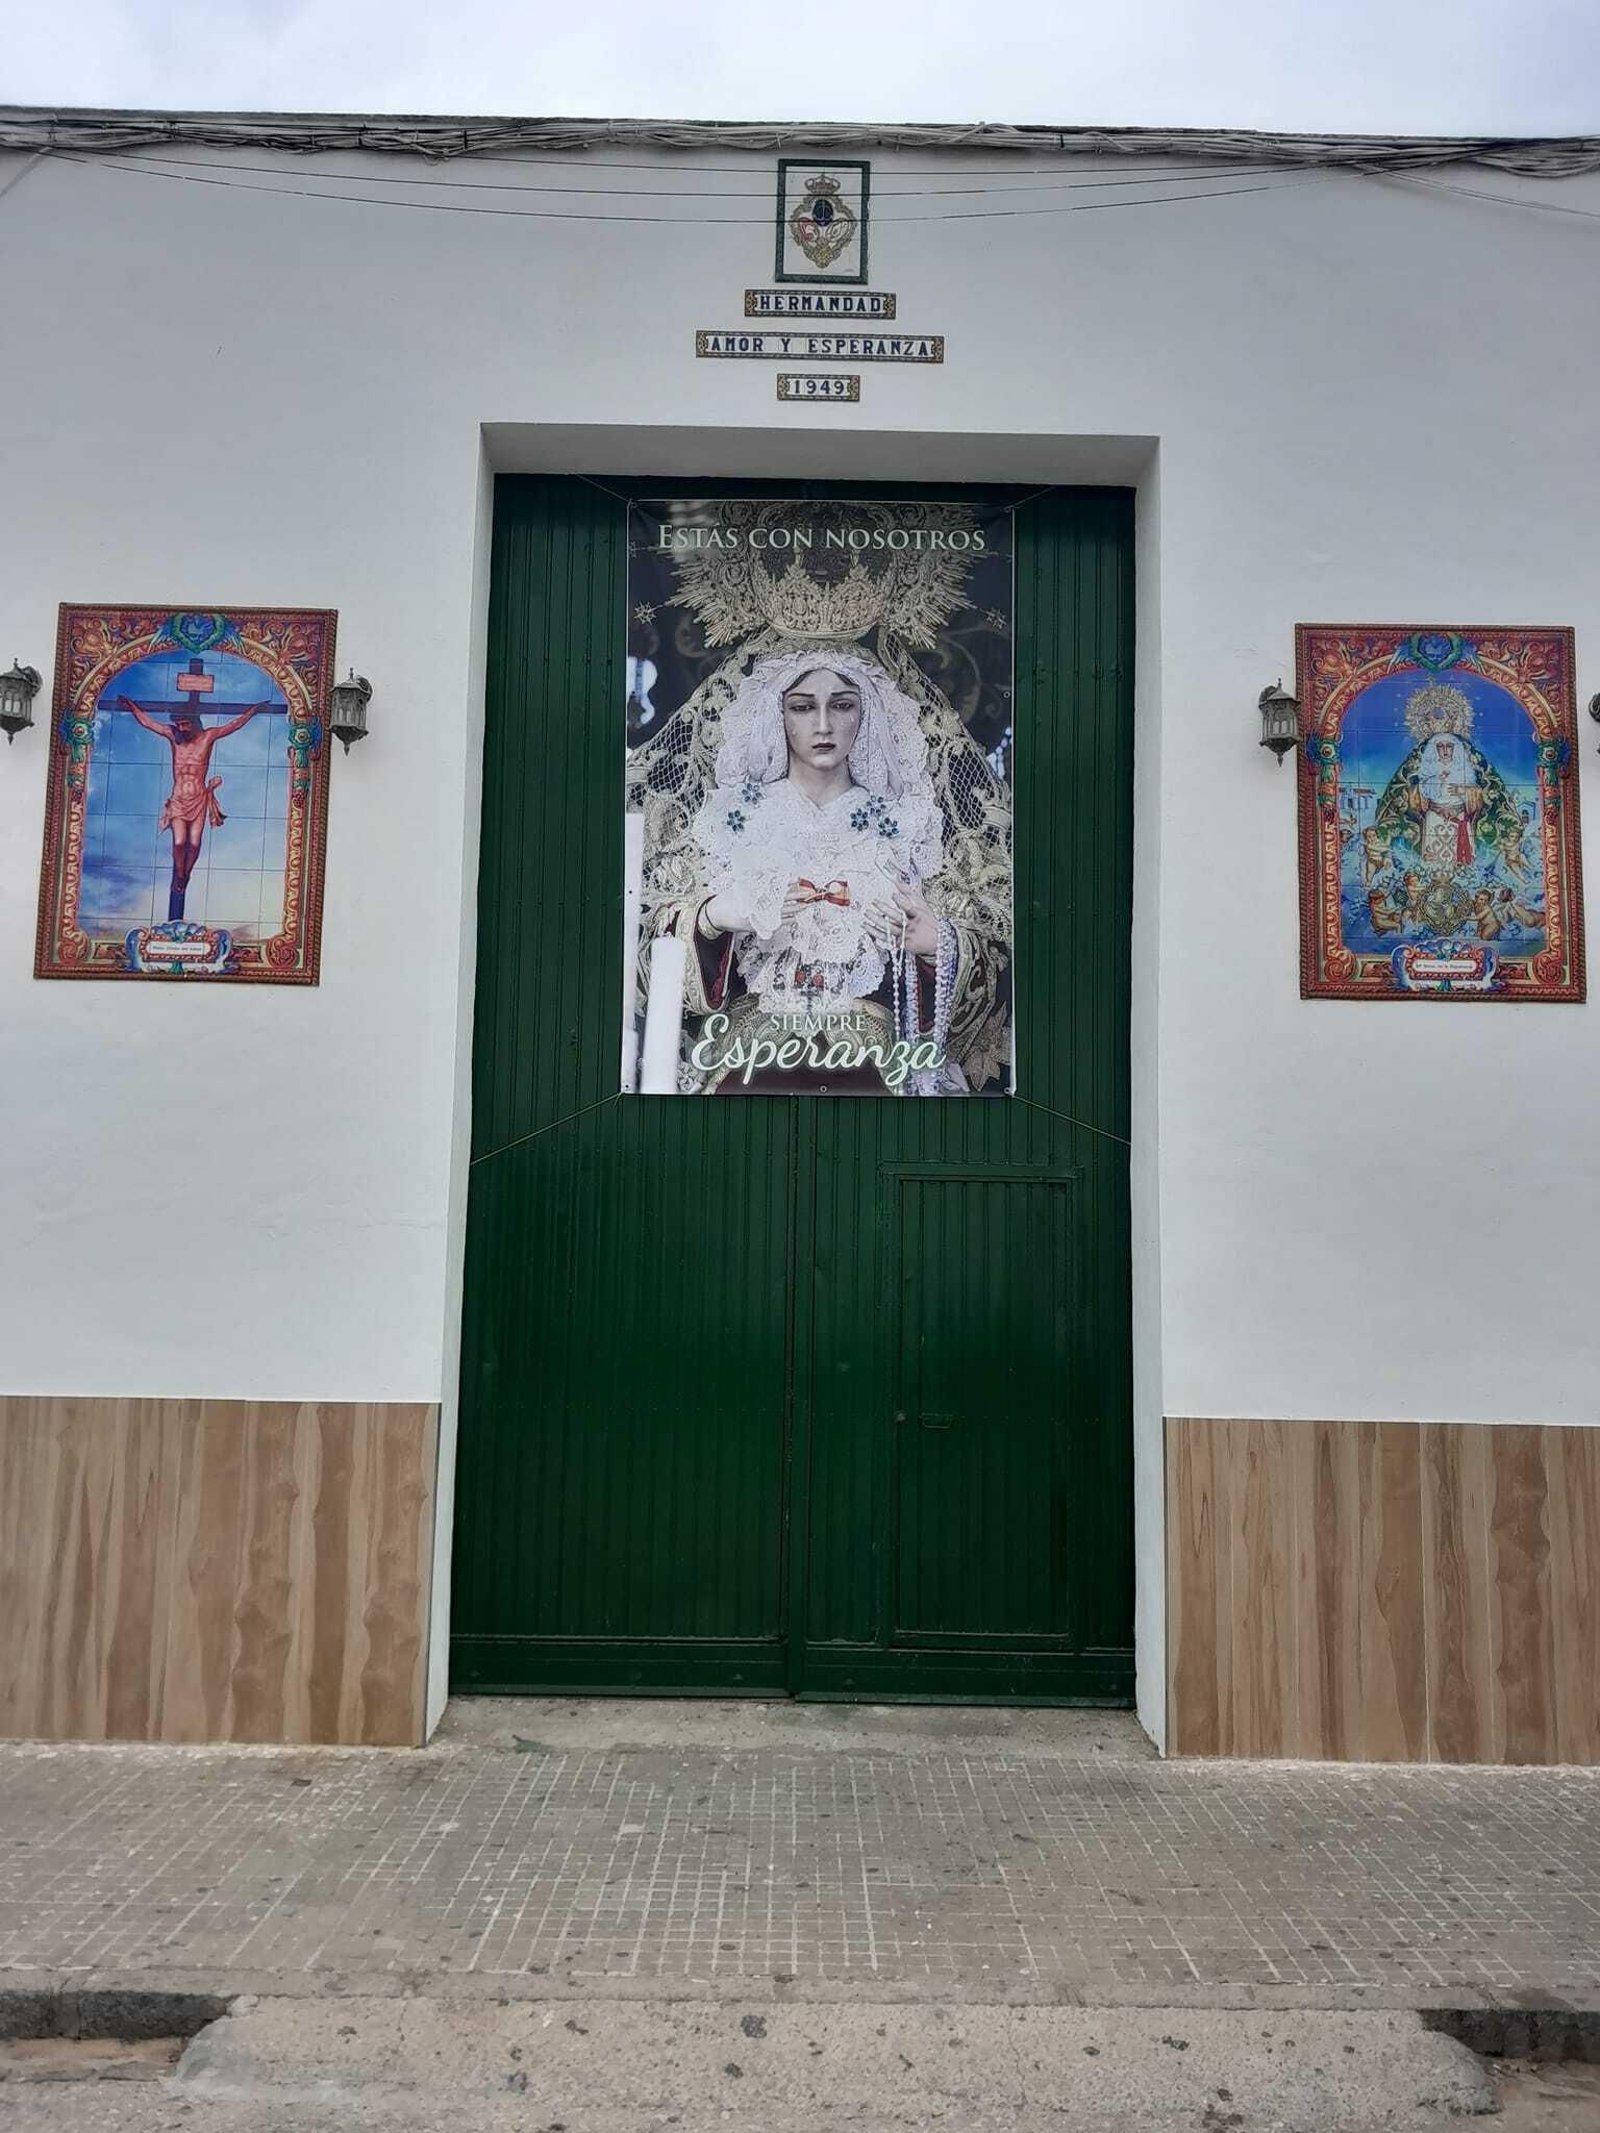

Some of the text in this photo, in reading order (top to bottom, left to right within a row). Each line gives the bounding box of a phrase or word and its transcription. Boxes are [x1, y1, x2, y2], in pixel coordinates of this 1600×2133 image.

[760, 294, 881, 313] HERMANDAD
[711, 337, 928, 356] AMOR Y ESPERANZA
[794, 379, 844, 395] 1949
[749, 527, 813, 549] CON
[825, 528, 985, 550] NOSOTROS
[770, 1014, 867, 1031] SIEMPRE
[691, 1013, 946, 1086] Esperanza
